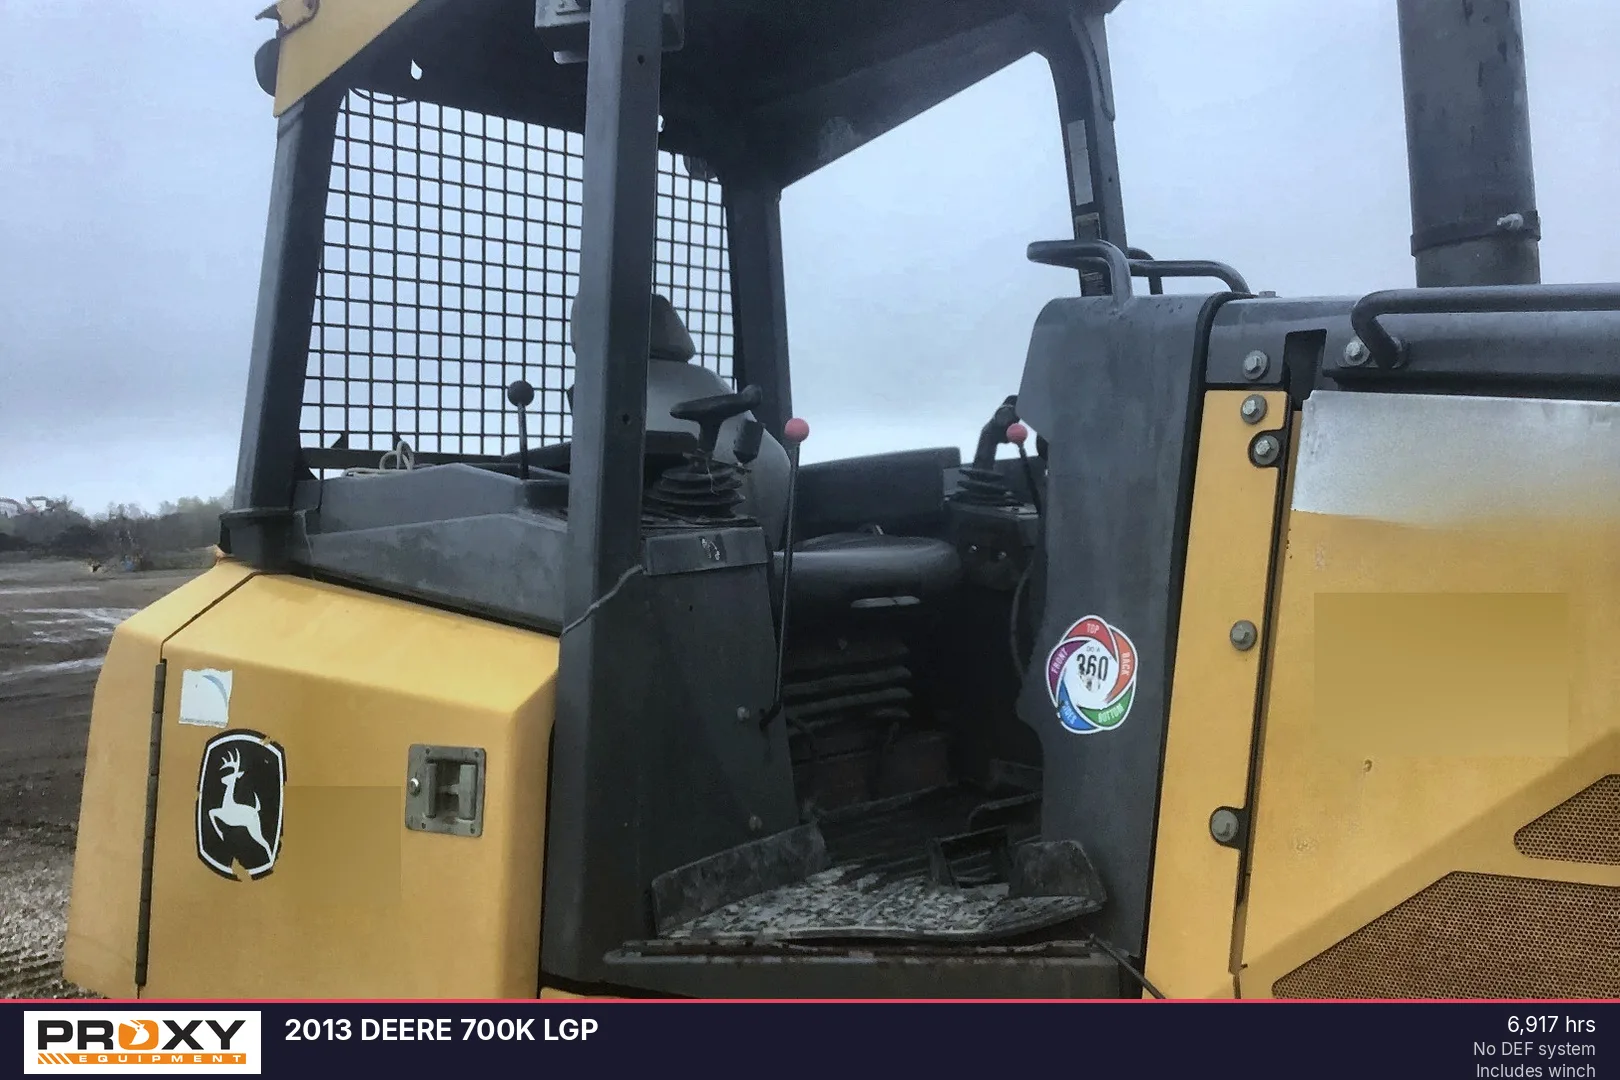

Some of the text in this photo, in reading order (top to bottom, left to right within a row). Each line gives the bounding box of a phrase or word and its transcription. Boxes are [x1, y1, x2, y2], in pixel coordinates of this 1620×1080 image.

[1086, 623, 1100, 635] TOP
[1051, 647, 1068, 674] FRONT
[1120, 651, 1131, 676] BACK
[1097, 703, 1125, 723] BOTTOM
